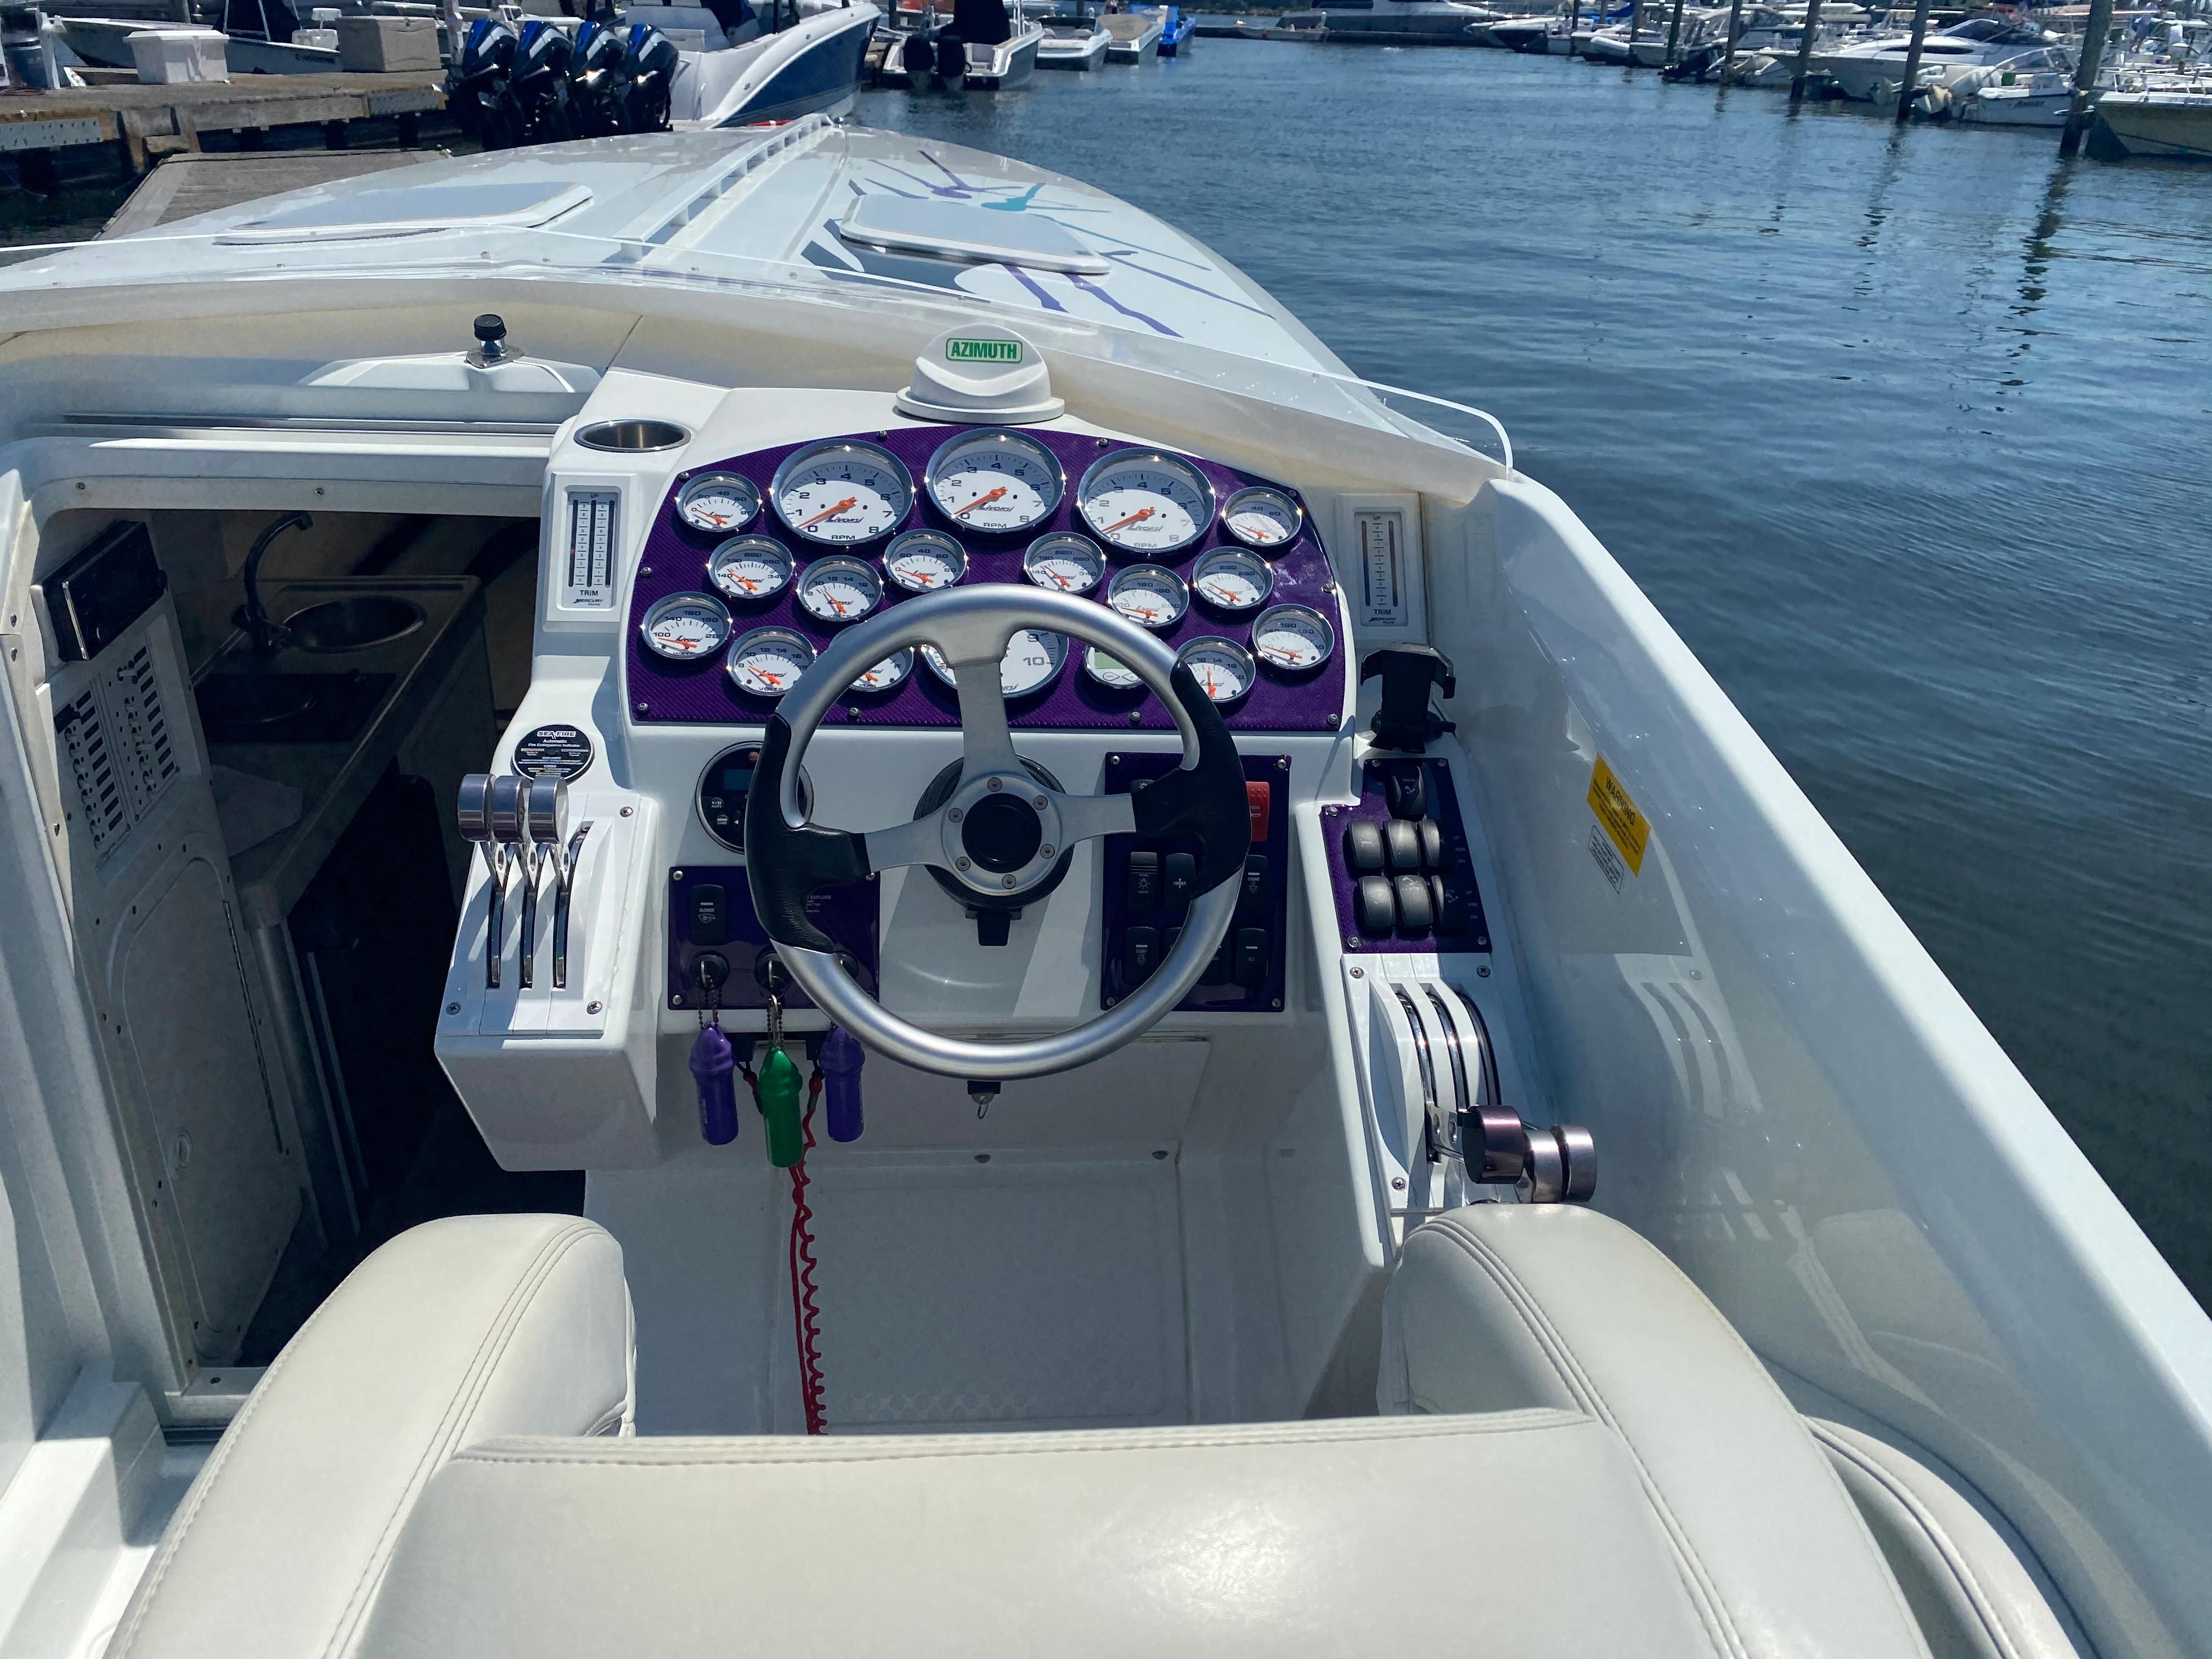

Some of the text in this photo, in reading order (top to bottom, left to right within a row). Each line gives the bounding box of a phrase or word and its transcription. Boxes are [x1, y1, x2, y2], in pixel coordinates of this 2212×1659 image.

[951, 342, 1017, 359] AZIMUTH
[975, 503, 1015, 512] Livorsi
[824, 514, 864, 523] Livorsi
[1026, 634, 1040, 642] 9
[1023, 657, 1045, 665] 10
[1606, 776, 1636, 826] WARNING
